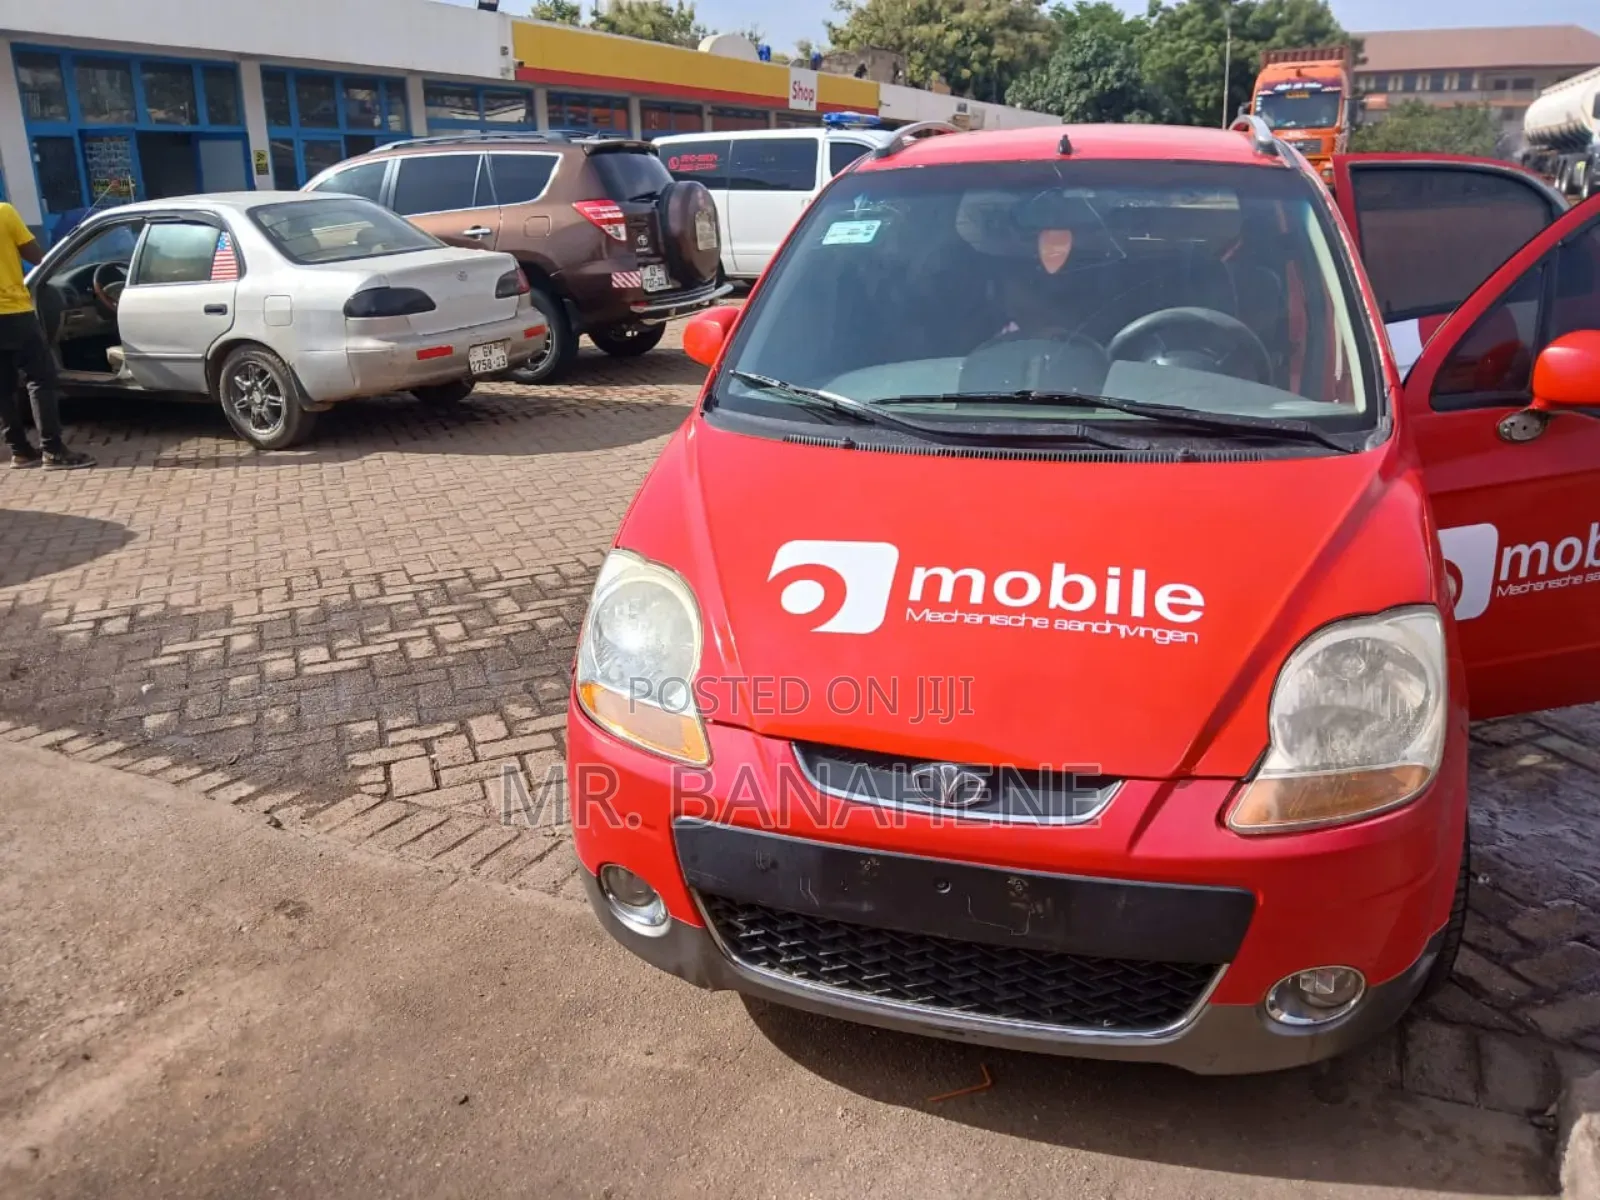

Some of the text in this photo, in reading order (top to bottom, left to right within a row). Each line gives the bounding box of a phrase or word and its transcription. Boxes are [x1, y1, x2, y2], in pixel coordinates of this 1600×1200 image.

[792, 80, 814, 107] Shop
[908, 562, 1205, 623] mobile
[905, 607, 1199, 645] Mechanische aandrijvingen
